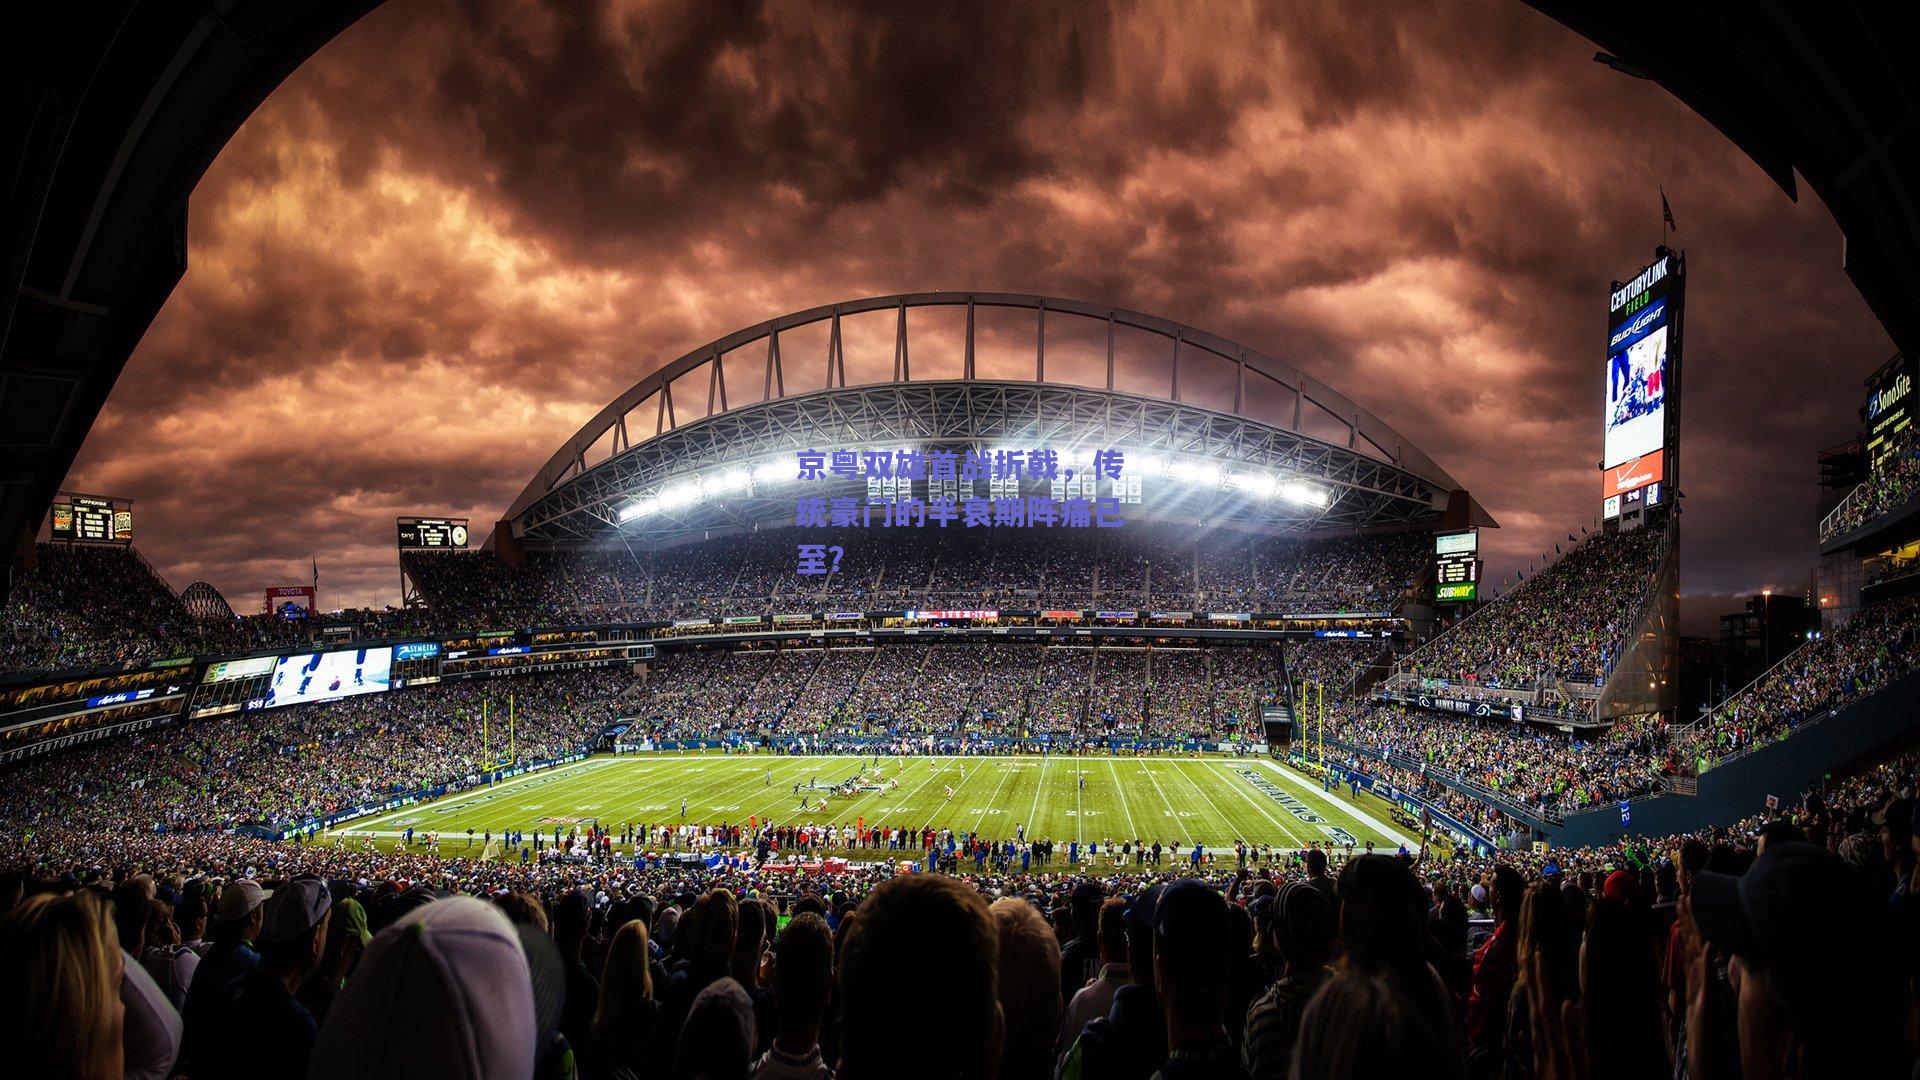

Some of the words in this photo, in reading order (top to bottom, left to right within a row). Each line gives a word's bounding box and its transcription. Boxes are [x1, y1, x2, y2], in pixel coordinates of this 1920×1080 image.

[1610, 256, 1668, 312] CENTURYLINK
[1626, 291, 1650, 316] FIELD
[1610, 327, 1632, 346] BUD
[1633, 306, 1664, 330] LIGHT
[1878, 373, 1911, 413] SonoSite
[1873, 407, 1905, 434] DEFENSE
[80, 499, 107, 507] OFFENSE
[401, 532, 414, 540] bing
[278, 588, 304, 596] TOYOTA
[1437, 585, 1474, 598] SUBWAY
[410, 644, 438, 652] SYMETRA
[490, 669, 516, 677] HOME
[9, 750, 23, 762] TO
[30, 728, 113, 756] CENTURYLINK
[118, 721, 153, 735] FIELD
[1233, 768, 1329, 823] SEAHAWKS
[1620, 806, 1630, 822] 12
